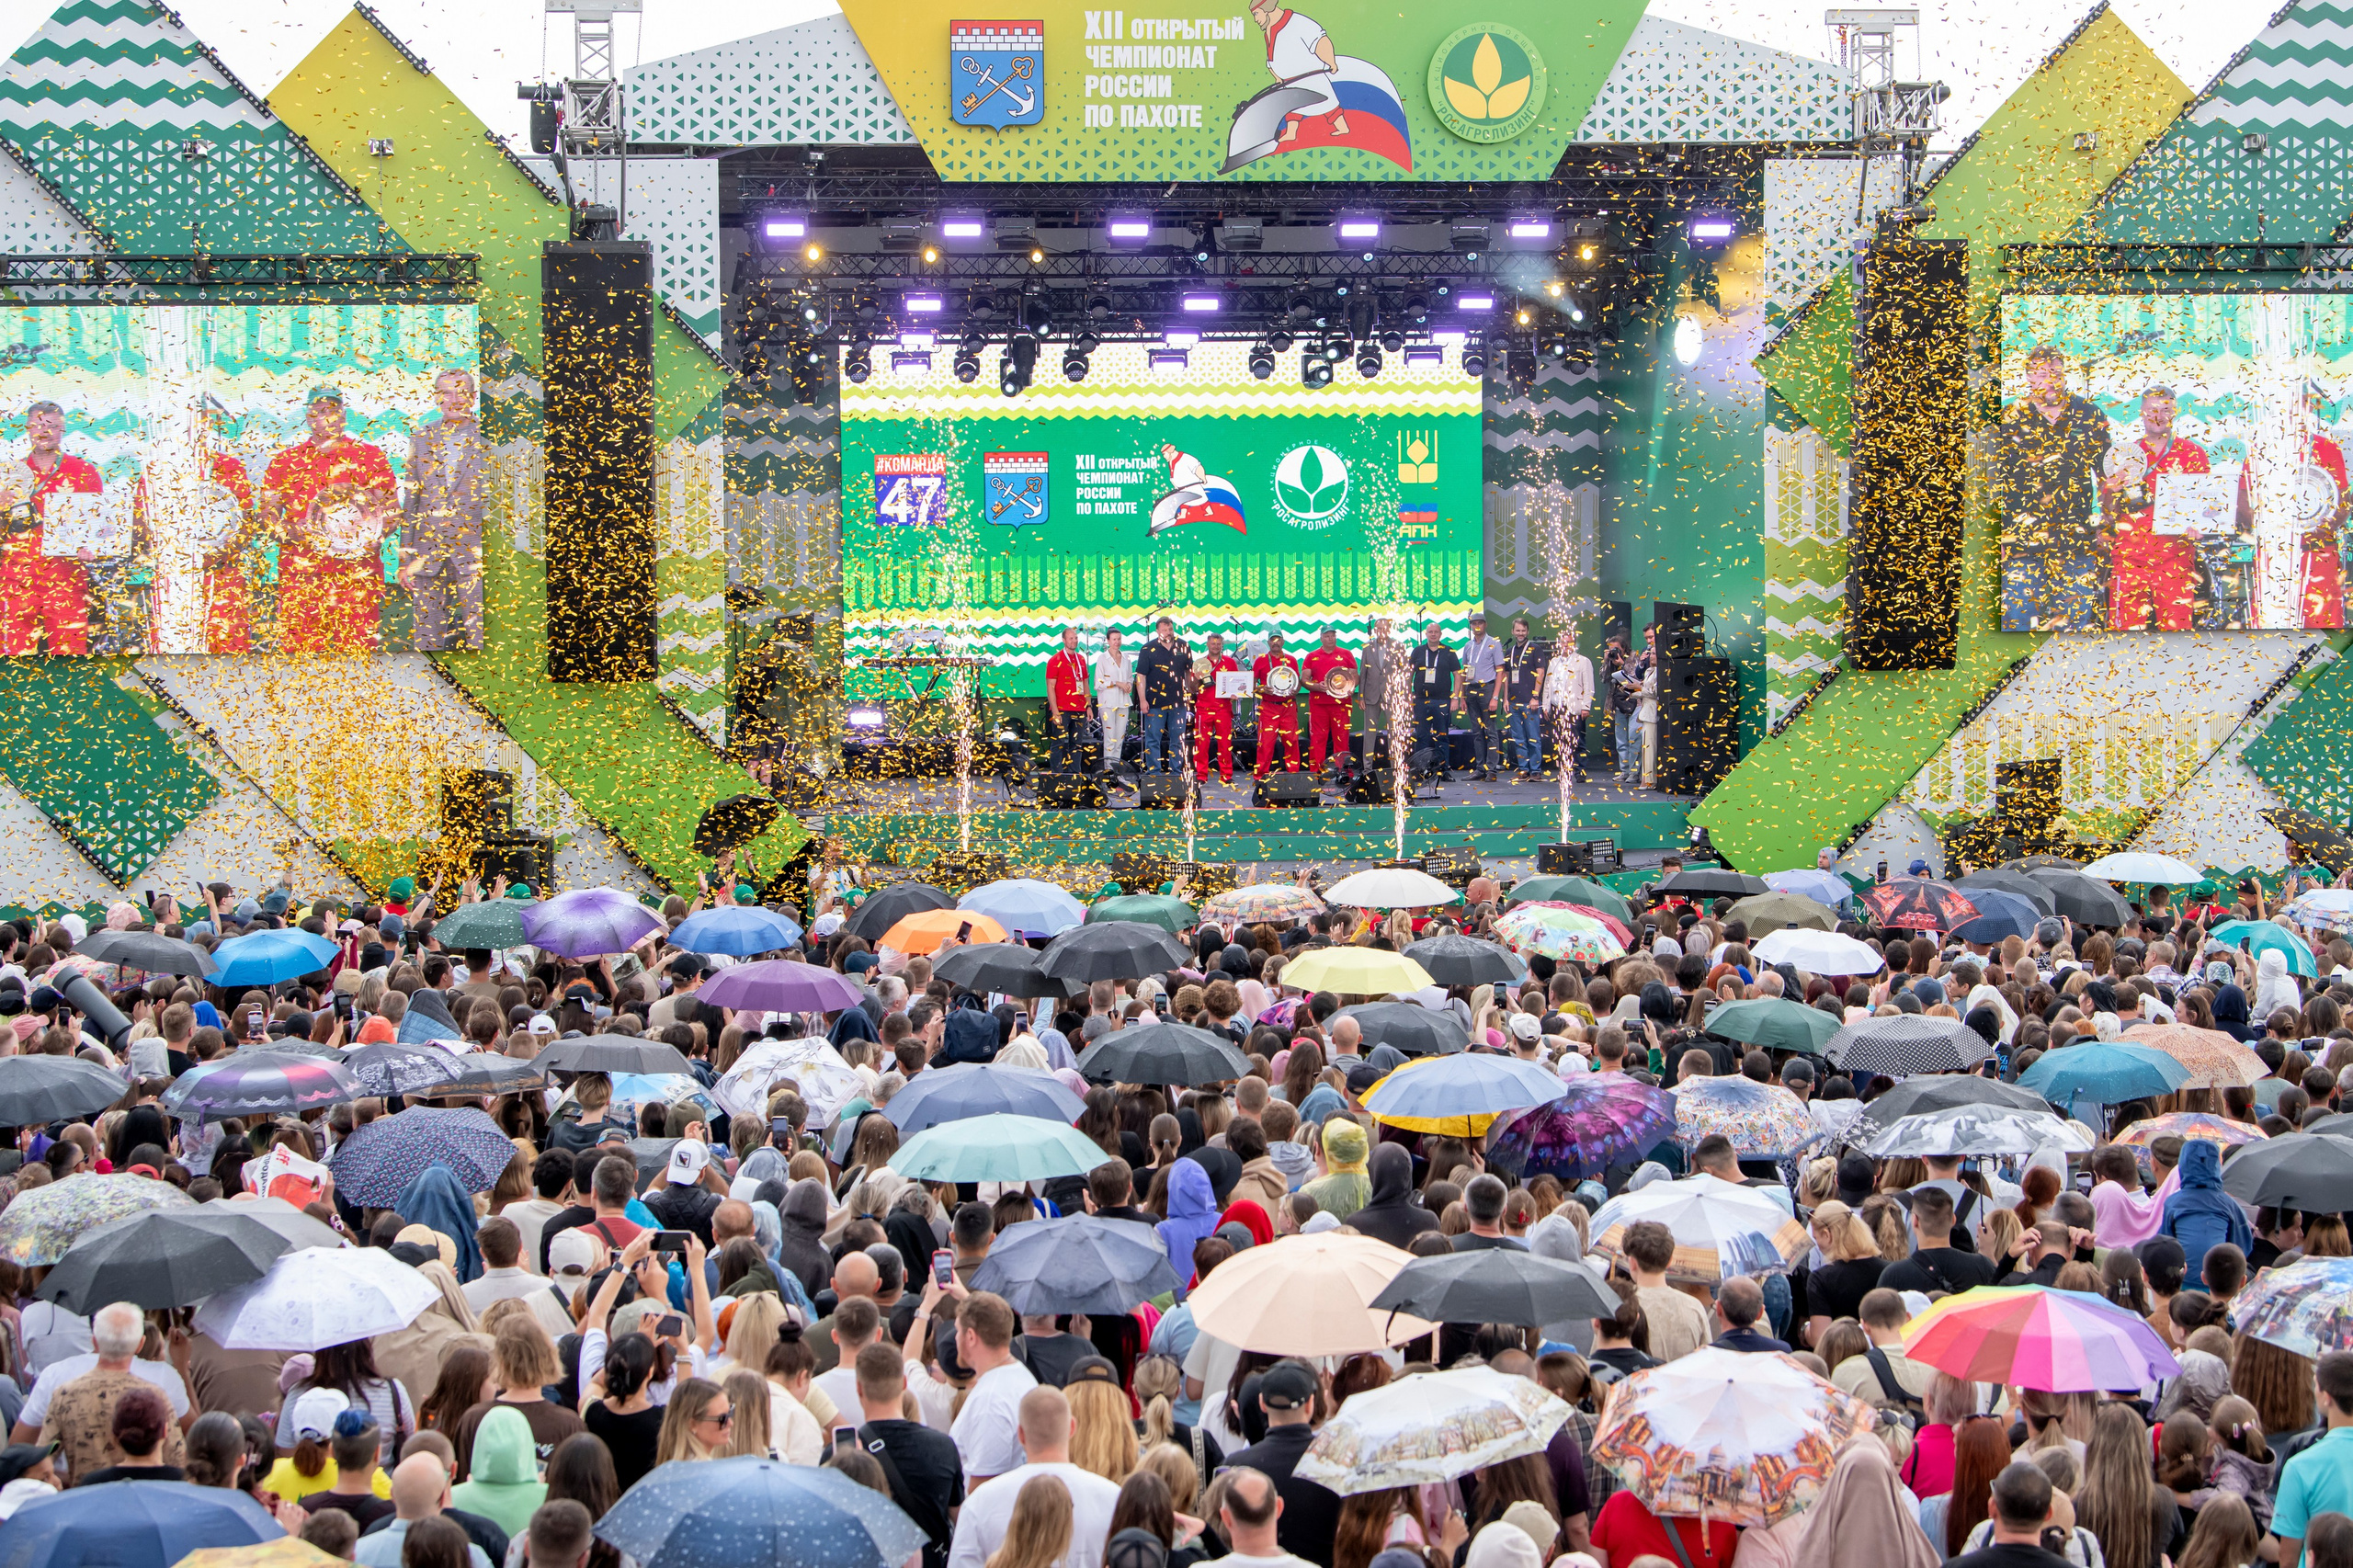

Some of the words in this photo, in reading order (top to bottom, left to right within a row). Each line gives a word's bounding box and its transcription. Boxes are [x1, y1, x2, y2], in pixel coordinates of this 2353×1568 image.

[1085, 11, 1122, 40] XII
[1131, 17, 1245, 40] ОТКРЫТЫЙ
[1086, 46, 1217, 68] ЧЕМПИОНАТ
[1435, 25, 1495, 90] АКЦИОНЕРНОЕ
[1505, 29, 1540, 90] ОБЩЕСТВО
[1085, 74, 1172, 97] РОССИИ
[1085, 105, 1114, 128] ПО
[1120, 105, 1202, 128] ПАХОТЕ
[876, 457, 945, 473] #КОМАНДА
[1075, 454, 1095, 470] XII
[1098, 457, 1157, 470] ОТКРЫТЫЙ
[1076, 472, 1144, 484] ЧЕМПИОНАТ
[880, 477, 941, 523] 47
[1076, 487, 1121, 499] РОССИИ
[1076, 502, 1092, 515] ПО
[1095, 502, 1137, 515] ПАХОТЕ
[1399, 525, 1438, 538] АПК
